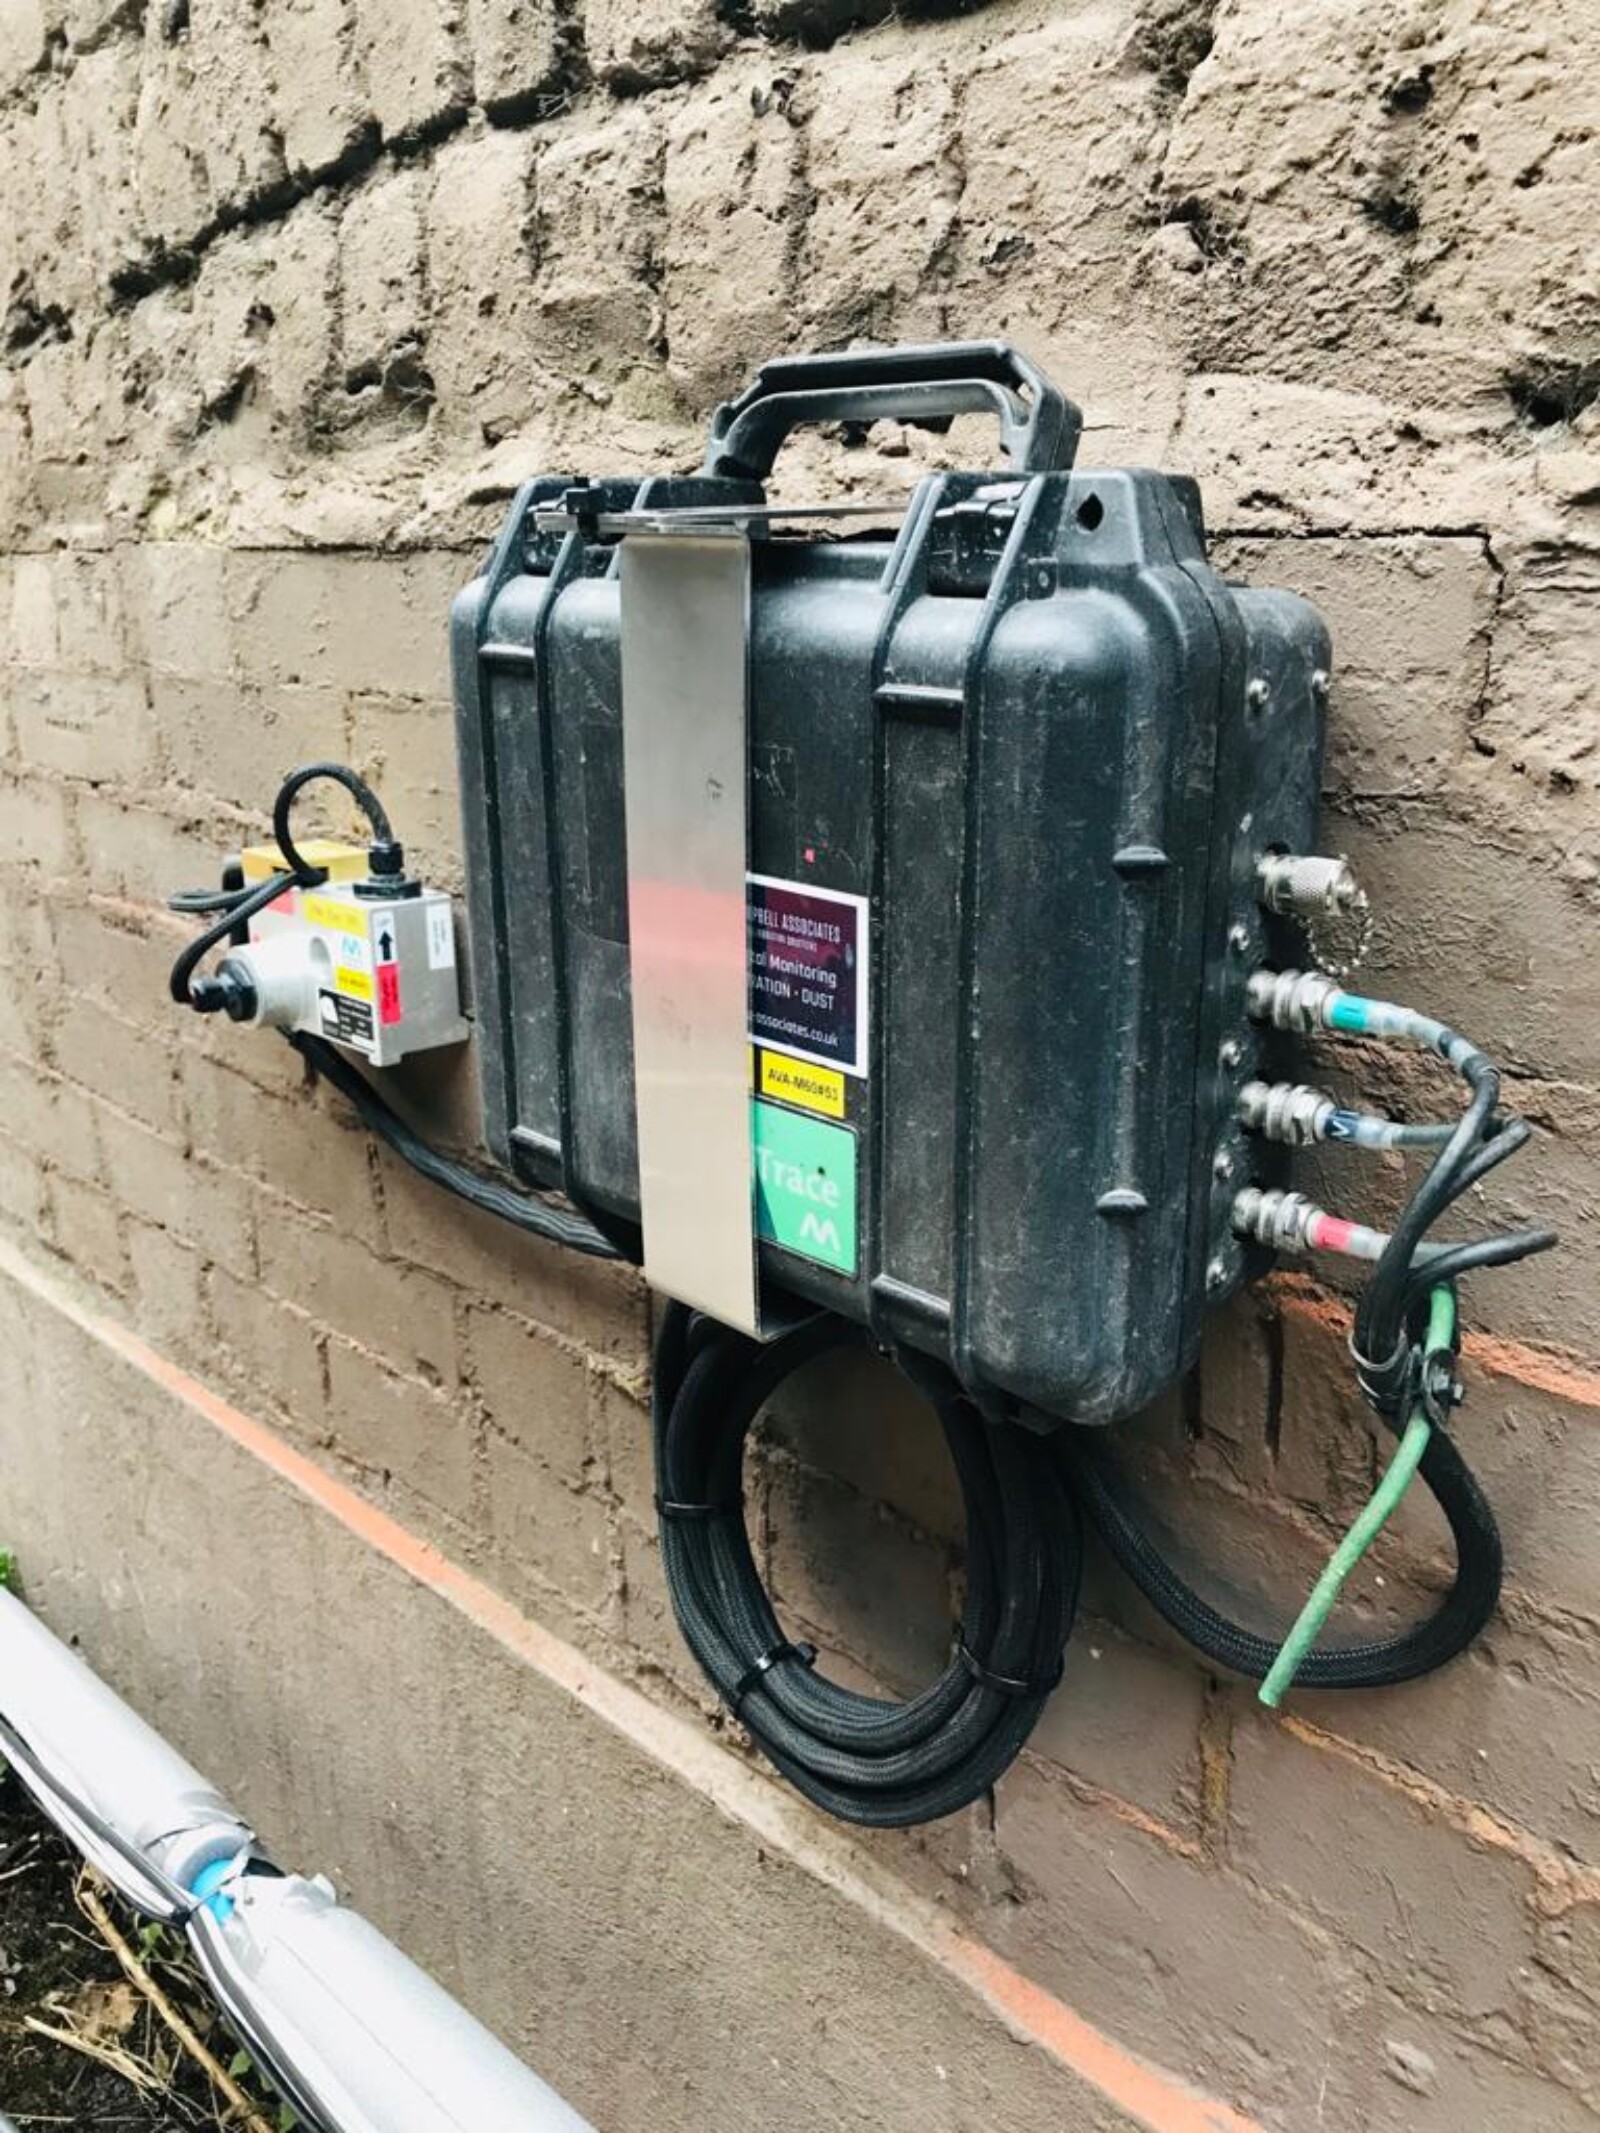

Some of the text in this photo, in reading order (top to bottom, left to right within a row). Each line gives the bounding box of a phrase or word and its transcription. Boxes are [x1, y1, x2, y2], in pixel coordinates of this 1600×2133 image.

[781, 913, 840, 944] ASSOCIATES
[769, 954, 837, 989] Monitoring
[801, 987, 835, 1013] DUST
[757, 1145, 840, 1210] Trace
